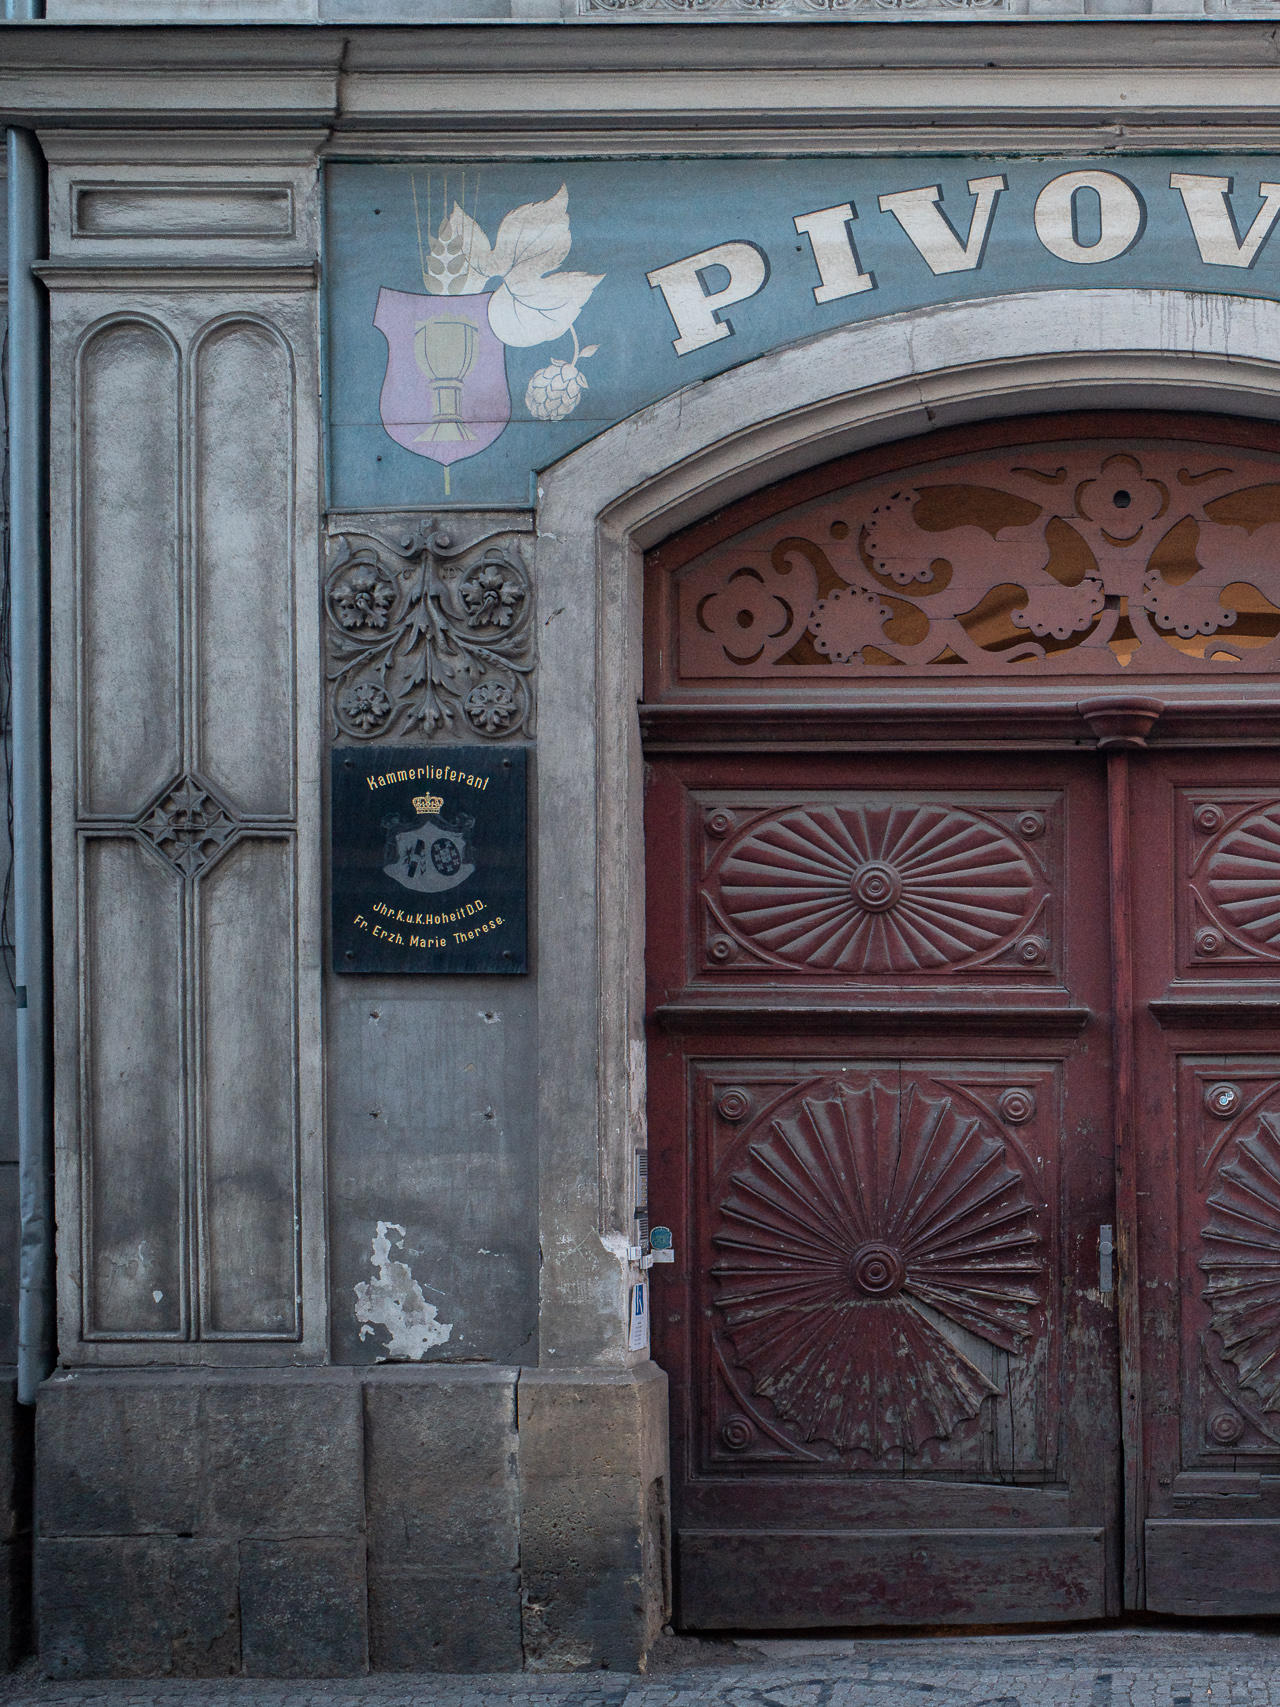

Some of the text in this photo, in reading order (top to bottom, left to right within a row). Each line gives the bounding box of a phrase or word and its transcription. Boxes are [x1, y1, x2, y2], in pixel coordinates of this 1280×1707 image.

[366, 765, 490, 791] Kammerlieferant
[353, 915, 505, 948] Fr. Erzh. Marie Therese.
